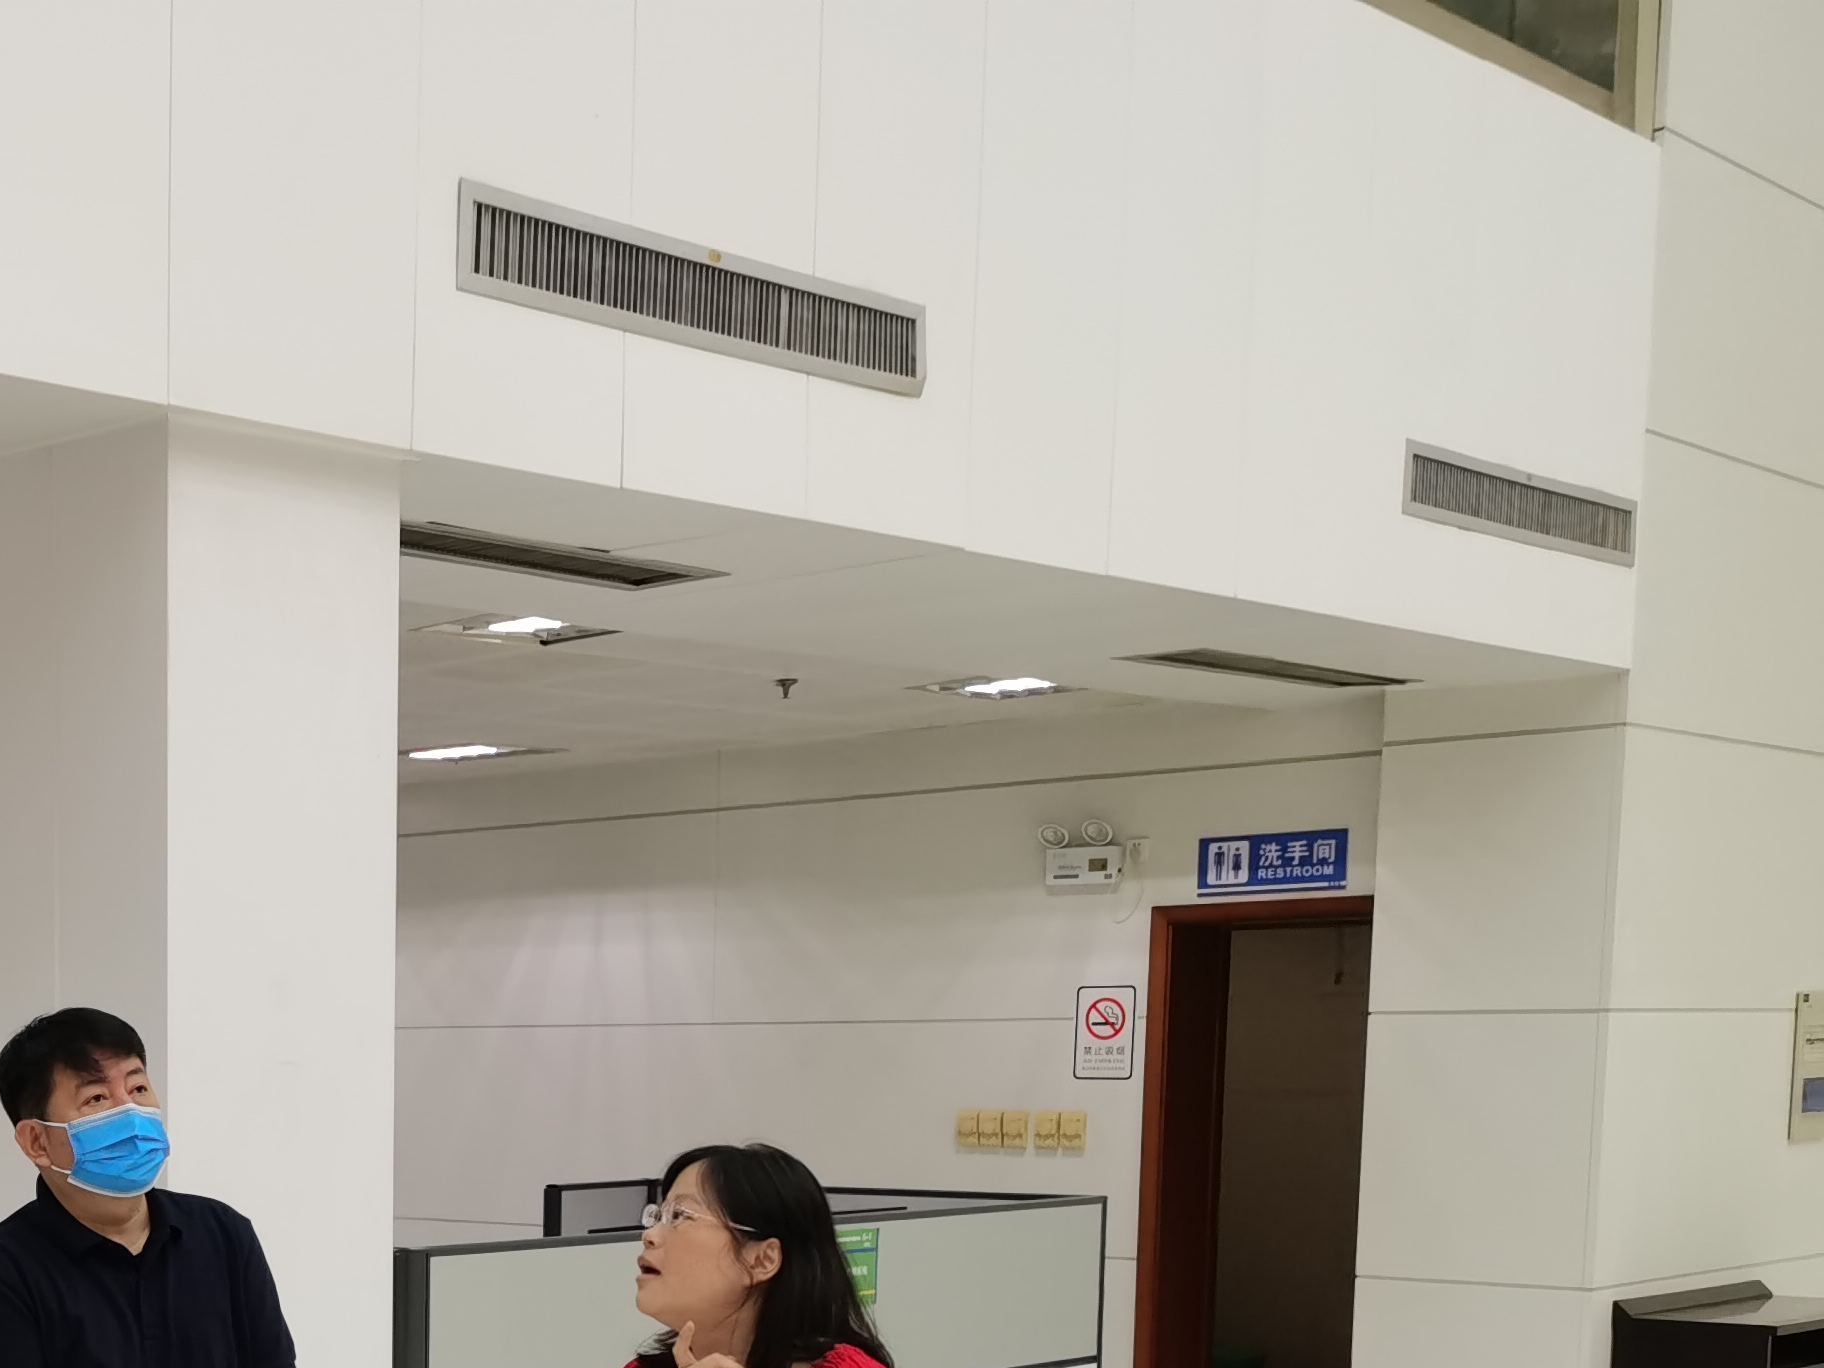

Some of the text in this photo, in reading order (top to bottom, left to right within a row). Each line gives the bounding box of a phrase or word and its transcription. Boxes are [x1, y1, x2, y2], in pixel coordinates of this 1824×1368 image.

[1259, 839, 1336, 866] 洗手间
[1258, 864, 1334, 880] RESTROOM
